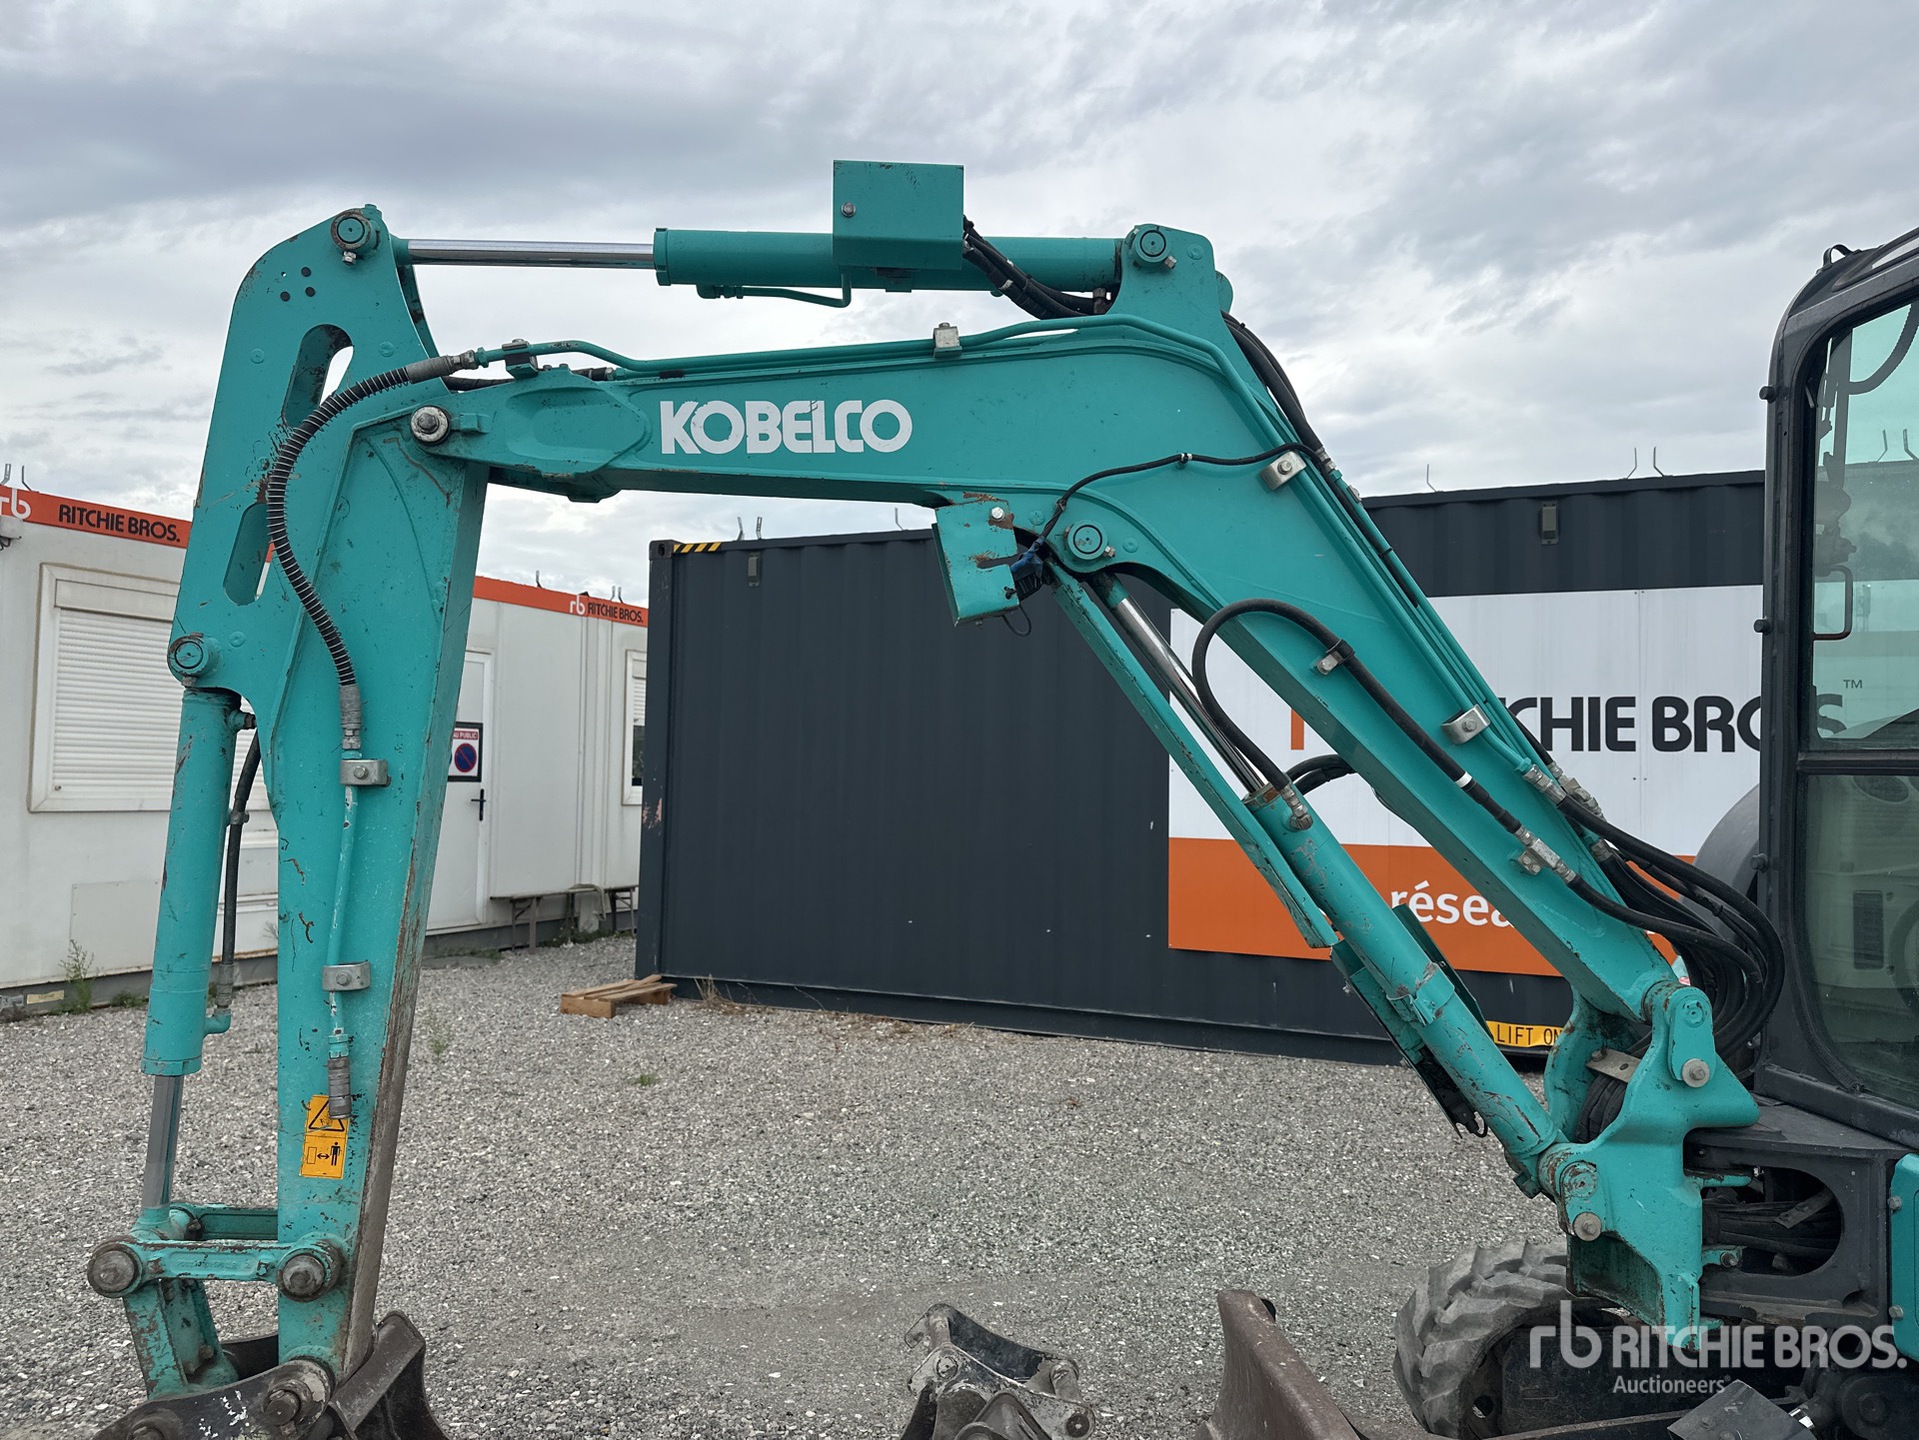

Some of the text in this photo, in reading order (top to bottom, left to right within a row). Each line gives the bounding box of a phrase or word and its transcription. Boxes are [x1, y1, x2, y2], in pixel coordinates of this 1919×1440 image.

[660, 399, 913, 455] KOBELCO
[59, 504, 125, 533] RITCHIE
[128, 517, 181, 543] BROS.
[588, 602, 618, 619] RITCHIE
[619, 608, 644, 624] BROS.
[1497, 1024, 1533, 1045] LIFT
